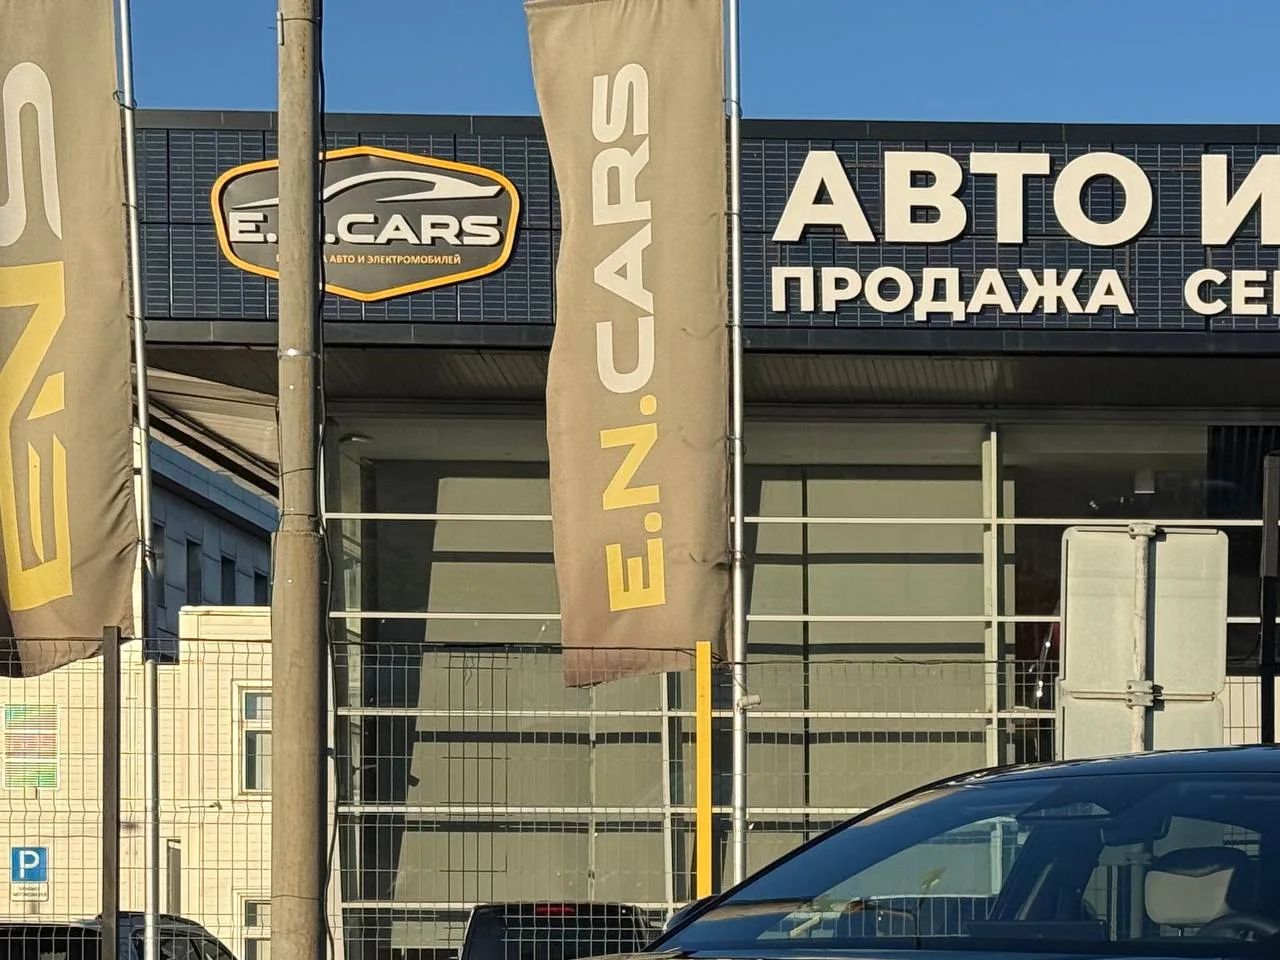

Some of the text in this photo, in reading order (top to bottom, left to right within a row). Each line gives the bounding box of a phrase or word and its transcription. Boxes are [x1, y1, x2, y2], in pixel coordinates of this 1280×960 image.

[771, 149, 1155, 247] АВТО
[228, 211, 501, 246] E..CARS
[330, 254, 355, 265] АВТО
[357, 255, 365, 265] И
[367, 253, 462, 266] ЭЛЕКТРОМОБИЛЕЙ
[771, 265, 1136, 322] ПРОДАЖА
[592, 62, 667, 612] E.N.CARS
